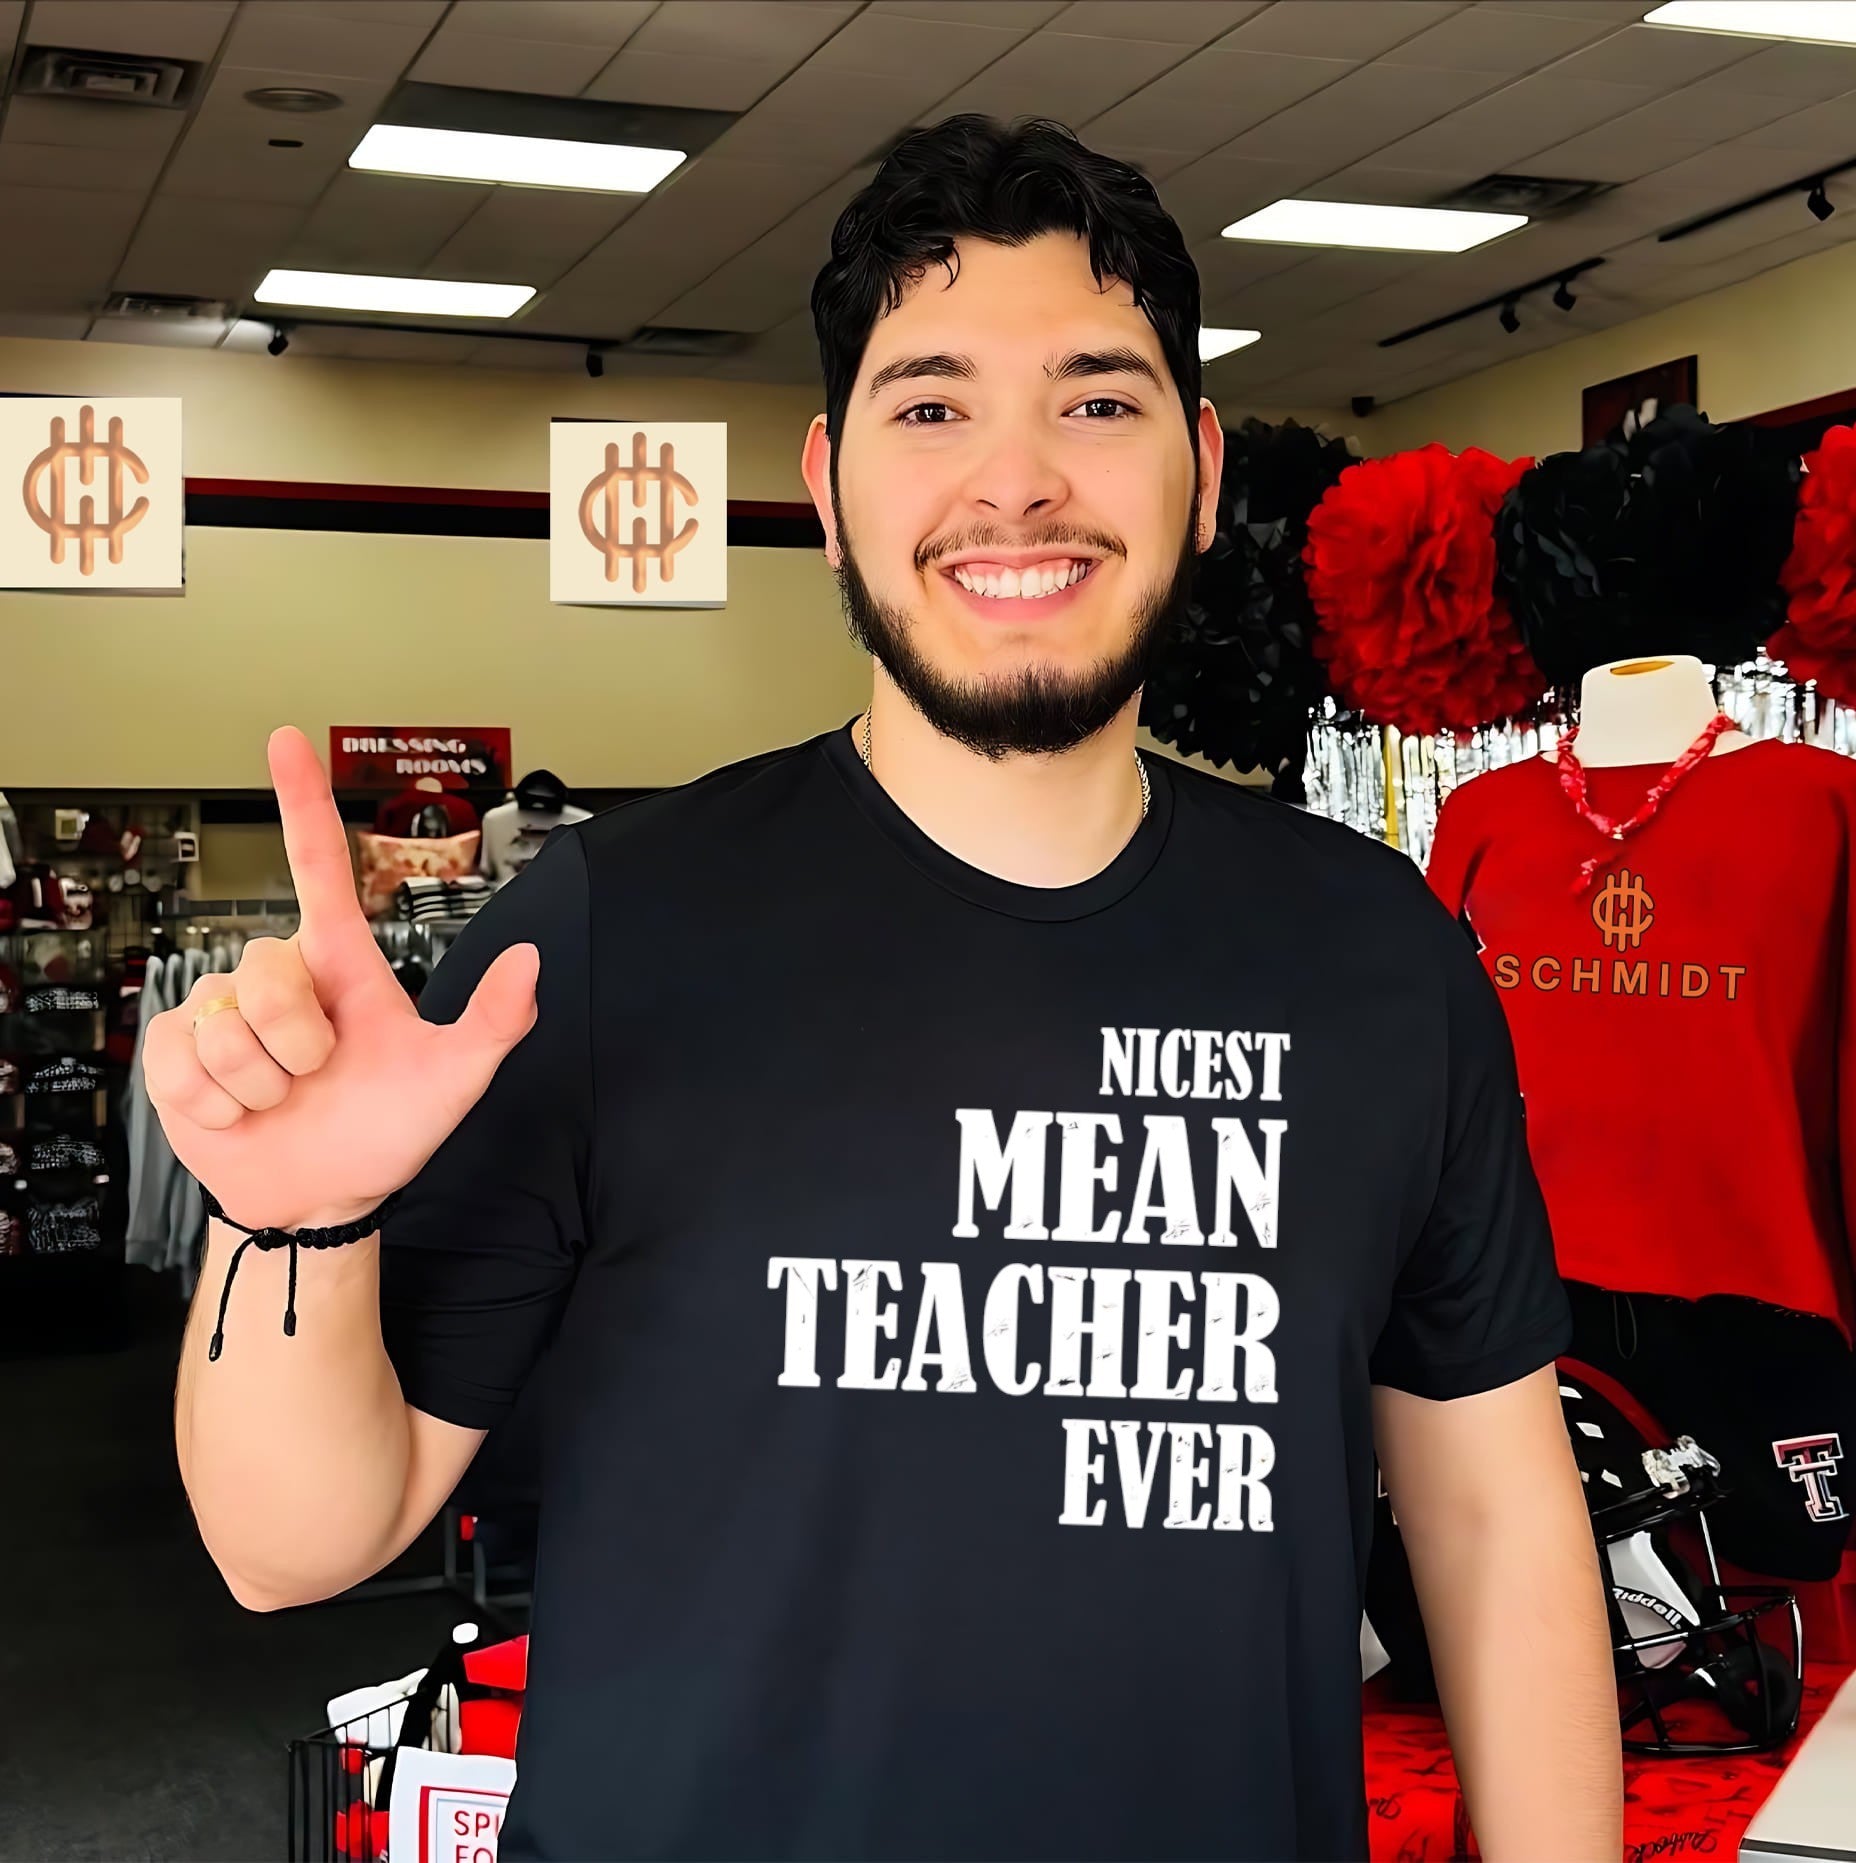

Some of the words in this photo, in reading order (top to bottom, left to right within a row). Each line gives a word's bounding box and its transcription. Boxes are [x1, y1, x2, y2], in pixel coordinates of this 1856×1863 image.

[1494, 953, 1746, 1000] SCHMIDT
[1099, 1027, 1290, 1101] NICEST
[952, 1108, 1288, 1248] MEAN
[767, 1257, 1280, 1403] TEACHER
[1059, 1419, 1276, 1532] EVER
